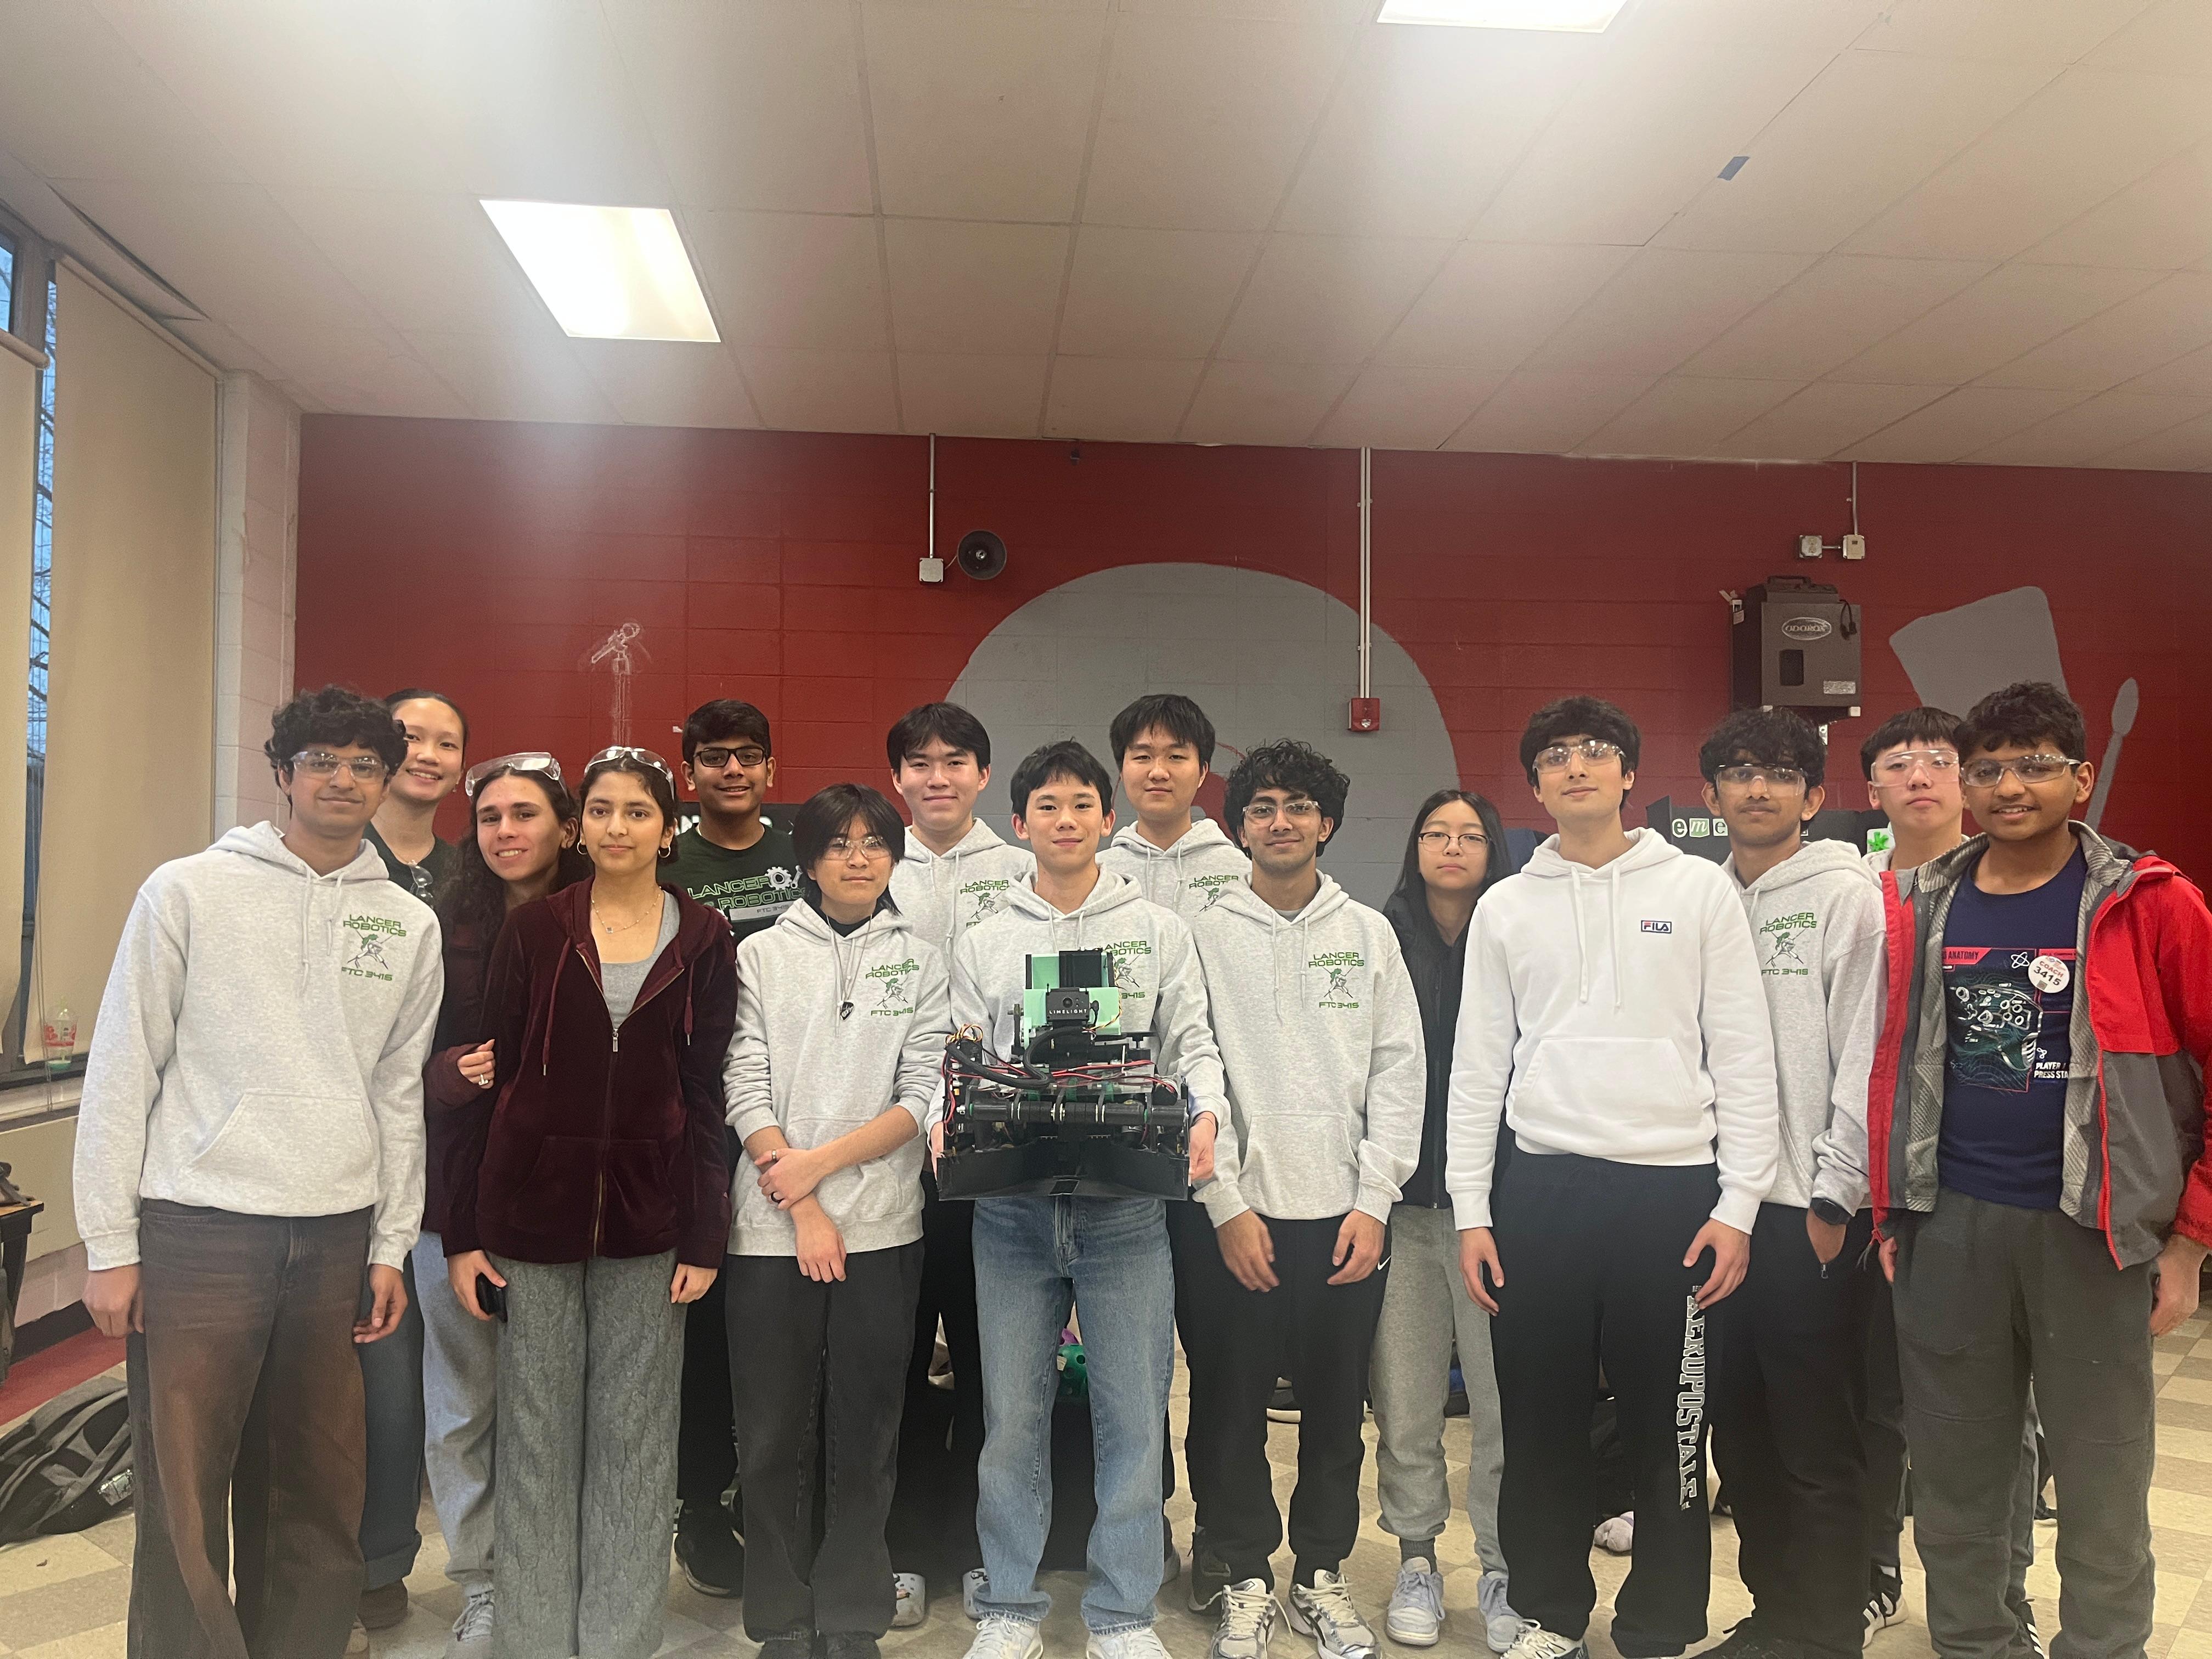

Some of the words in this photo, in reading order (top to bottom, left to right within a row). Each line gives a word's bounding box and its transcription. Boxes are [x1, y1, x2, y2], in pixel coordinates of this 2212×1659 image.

[687, 875, 771, 899] LANCER
[960, 885, 1010, 894] ROBOTIC
[1189, 880, 1228, 889] ROBOT
[349, 914, 401, 929] LANCER
[1766, 912, 1814, 926] LANCER
[343, 921, 407, 937] ROBOTICS
[1644, 922, 1669, 931] FILA
[1759, 921, 1817, 935] ROBOTICS
[1105, 941, 1147, 951] ANCER
[1111, 947, 1152, 956] BOTICS
[1313, 952, 1359, 960] LANCER
[1948, 951, 1979, 960] ANATOMY
[871, 958, 914, 971] LANCER
[1308, 959, 1364, 968] ROBOTICS
[341, 967, 364, 976] FTC
[365, 970, 393, 981] 3415
[865, 964, 919, 979] ROBOTICS
[2039, 961, 2064, 978] COACH
[2034, 966, 2061, 985] 3415
[2035, 1062, 2061, 1070] PLAYER
[2033, 1070, 2055, 1079] PRESS
[2056, 1070, 2069, 1079] STA
